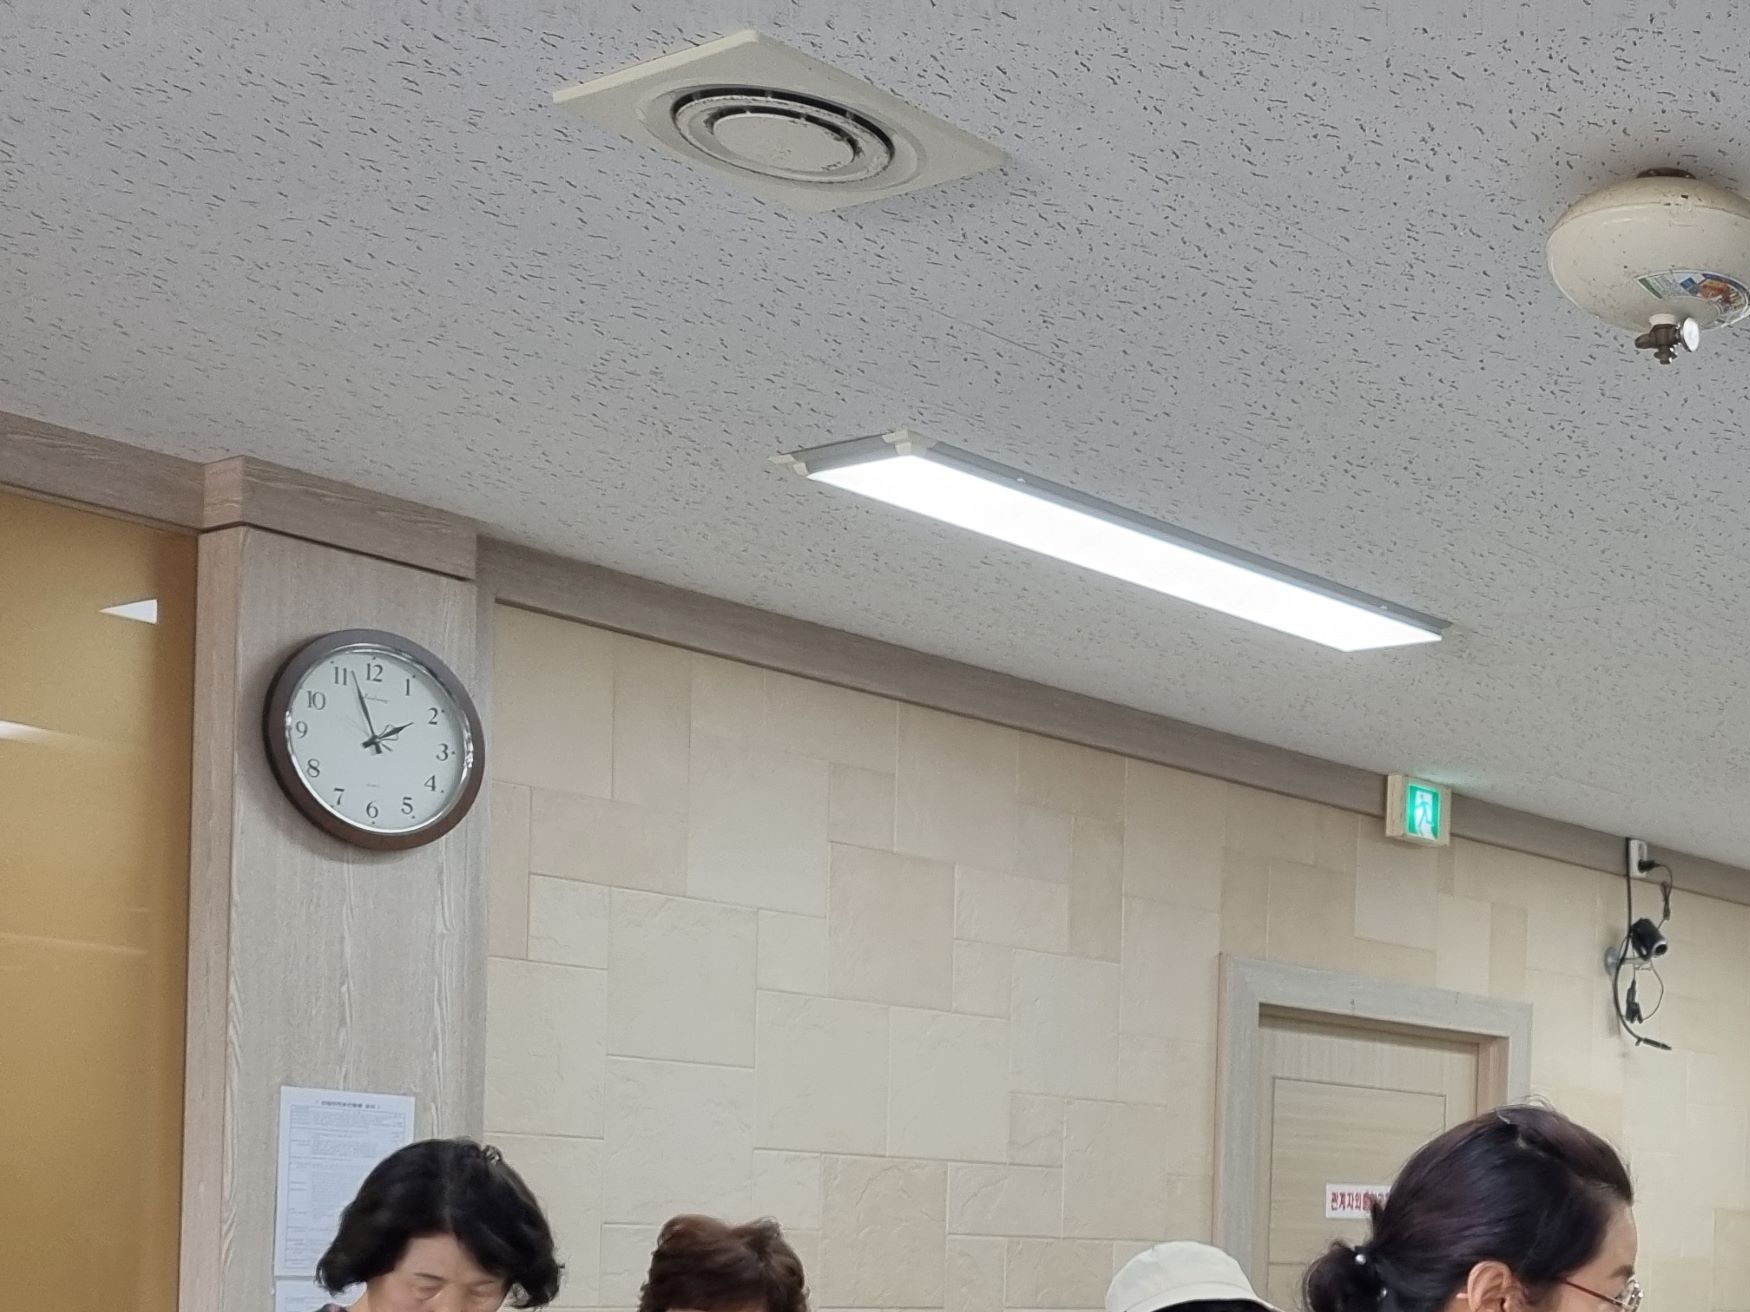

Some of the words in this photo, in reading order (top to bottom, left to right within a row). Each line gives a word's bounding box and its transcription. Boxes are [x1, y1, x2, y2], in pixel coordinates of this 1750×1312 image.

[334, 666, 348, 686] 11
[366, 663, 384, 682] 12
[404, 678, 411, 697] 1
[306, 690, 326, 711] 10
[427, 707, 439, 725] 2
[295, 720, 308, 739] 9
[435, 743, 449, 761] 3
[306, 758, 321, 778] 8
[423, 775, 436, 792] 4
[333, 787, 345, 806] 7
[400, 796, 413, 815] 5
[365, 801, 379, 819] 6
